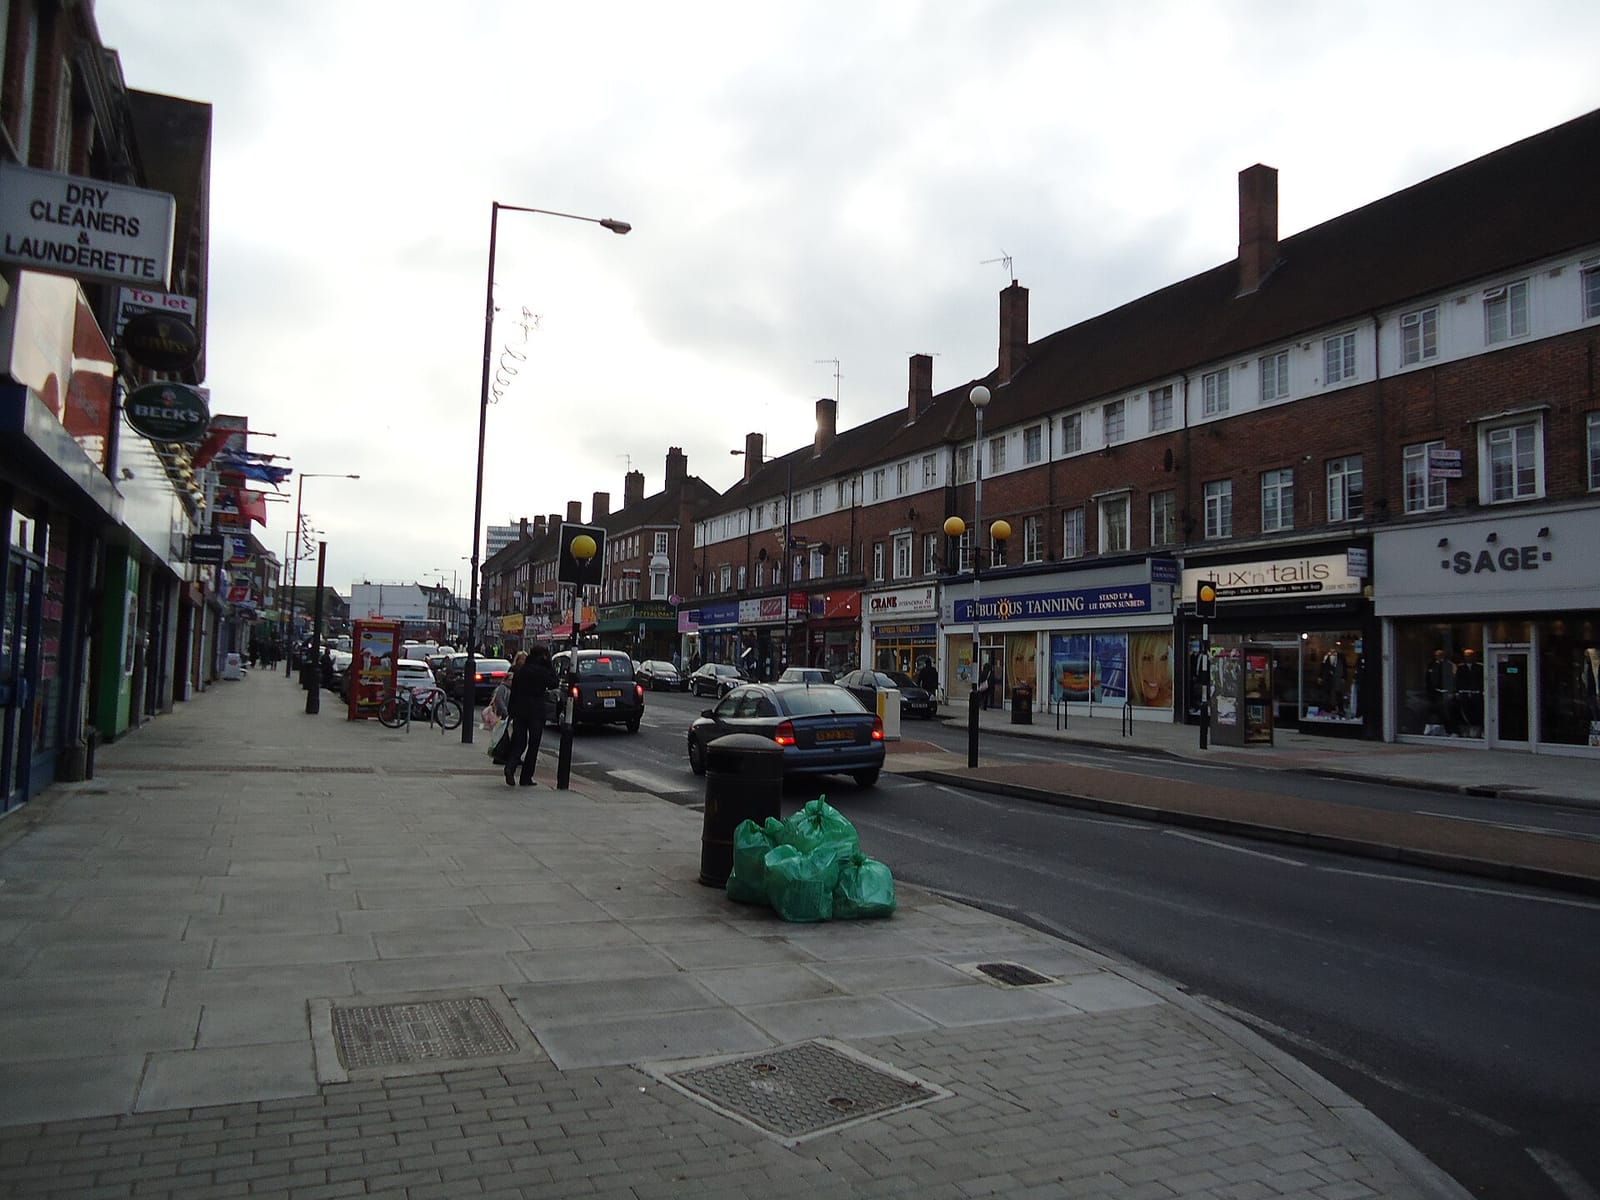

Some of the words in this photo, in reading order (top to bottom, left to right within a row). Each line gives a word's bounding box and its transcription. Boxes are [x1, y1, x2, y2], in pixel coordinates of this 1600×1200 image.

[66, 184, 109, 210] DRY
[30, 200, 140, 238] CLEANERS
[77, 231, 90, 246] &
[4, 235, 156, 278] LAUNDERETTE
[130, 287, 154, 304] To
[162, 293, 189, 310] let
[134, 403, 200, 423] BECK'S
[1453, 546, 1539, 575] SAGE
[1026, 596, 1085, 613] TANNING
[1098, 593, 1118, 601] STAND
[1119, 592, 1127, 600] UP
[1099, 601, 1117, 610] DOWN
